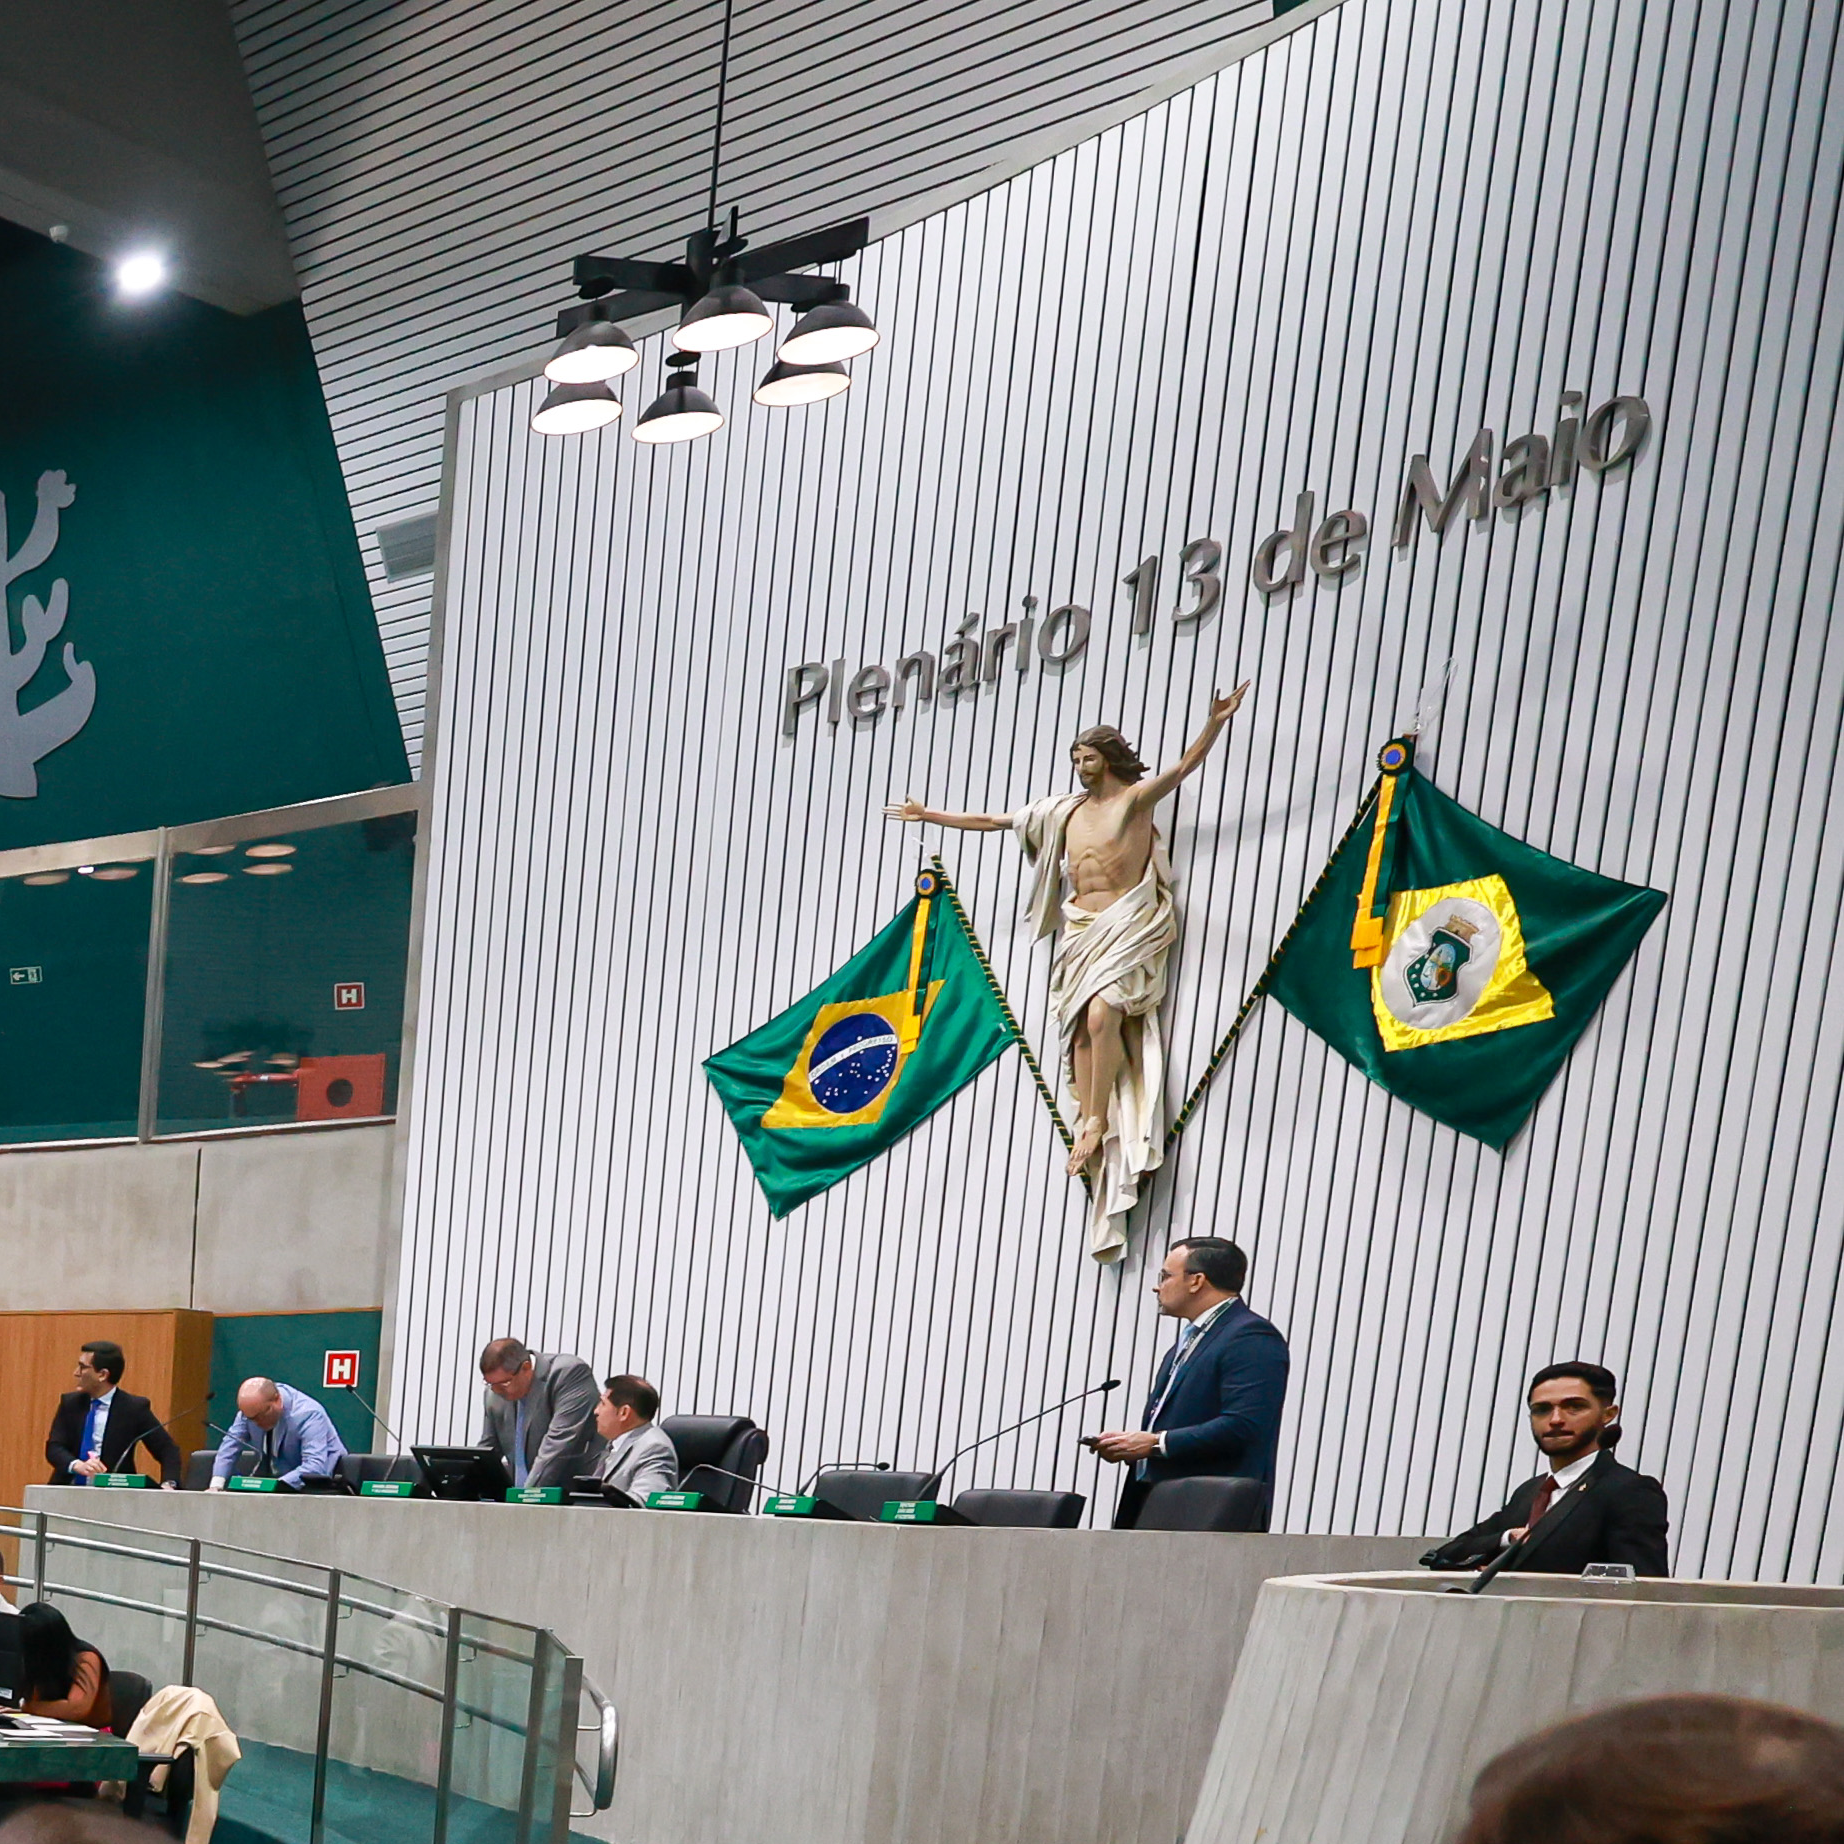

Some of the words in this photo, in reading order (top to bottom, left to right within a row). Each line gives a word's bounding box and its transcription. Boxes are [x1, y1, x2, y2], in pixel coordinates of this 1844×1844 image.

[782, 595, 1092, 737] Plenário
[1122, 537, 1222, 635] 13
[1253, 490, 1367, 594] de
[1392, 390, 1650, 548] Maio
[341, 988, 358, 1005] H
[331, 1358, 352, 1380] H
